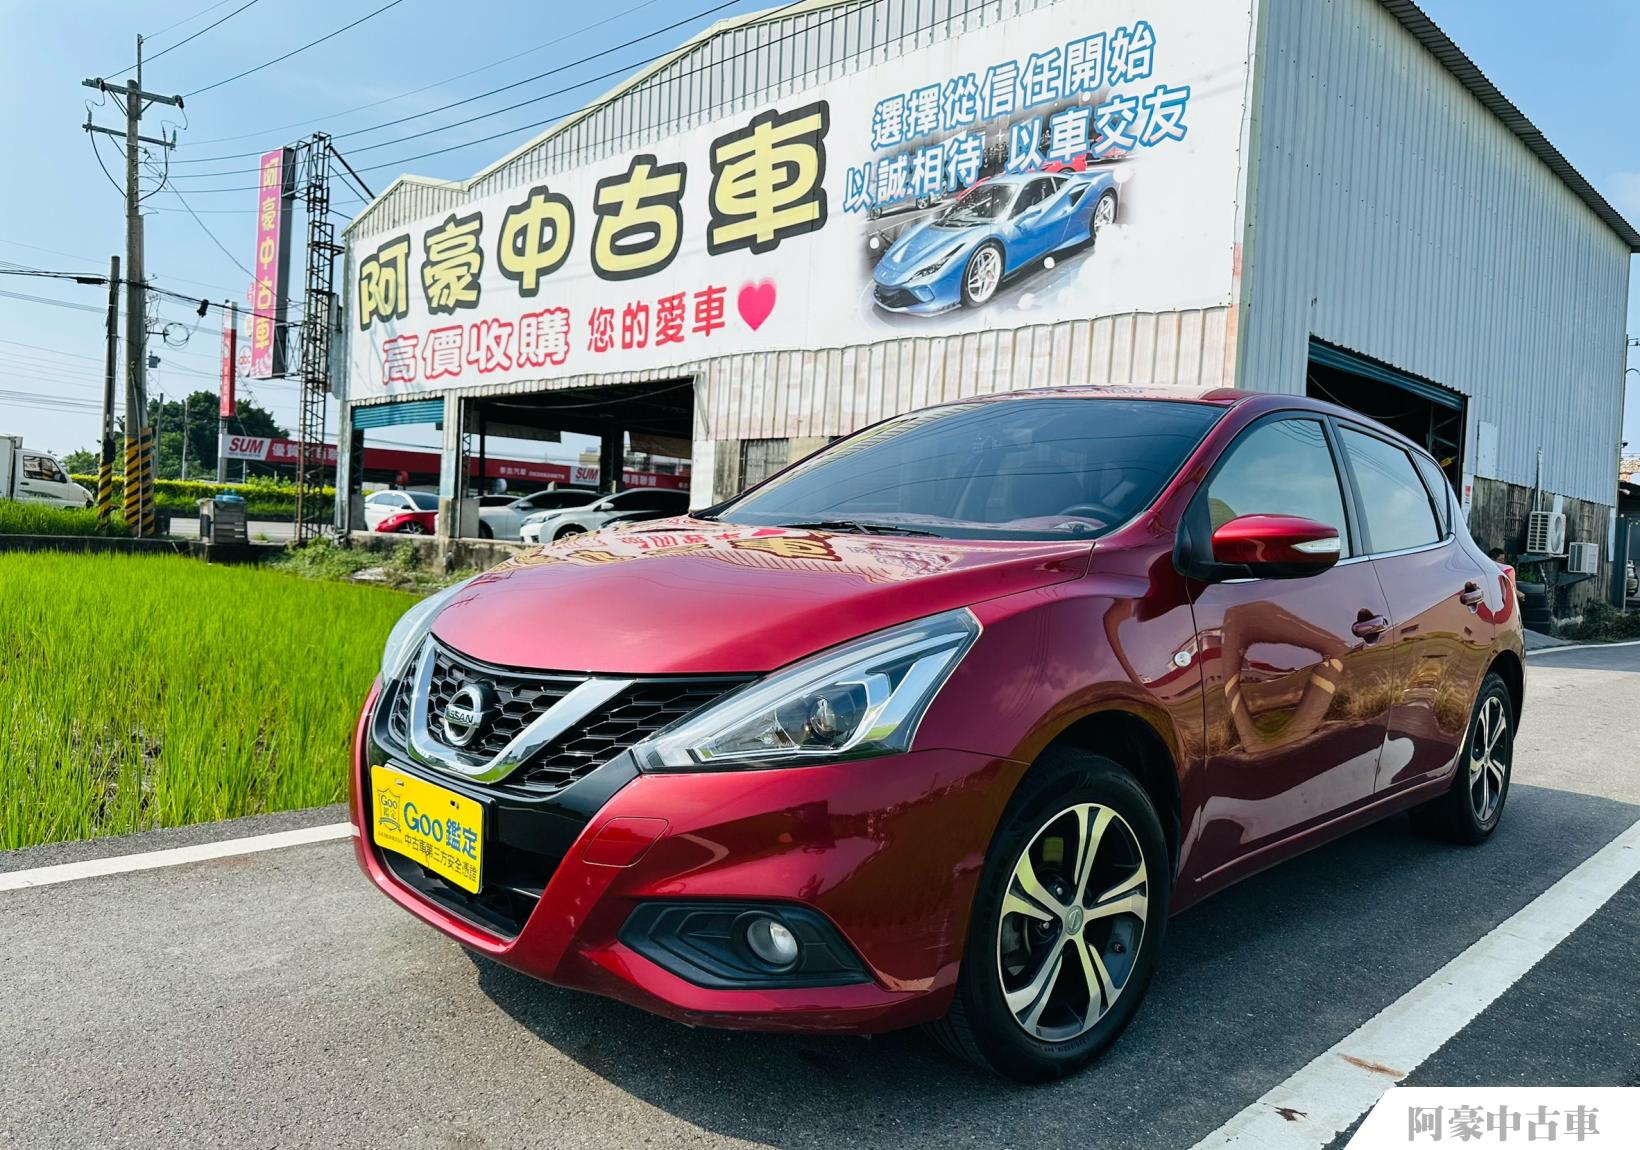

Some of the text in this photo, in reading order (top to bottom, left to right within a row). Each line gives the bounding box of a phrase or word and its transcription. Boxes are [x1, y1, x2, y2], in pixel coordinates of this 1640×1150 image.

[872, 20, 1156, 151] 選擇從信任開始
[842, 84, 1192, 214] 以誠相待 以車交友
[256, 157, 279, 349] 阿豪中古車
[358, 100, 830, 330] 阿豪中古車
[382, 284, 727, 385] 高價收購 您的愛車
[229, 437, 265, 453] SUM
[575, 467, 599, 481] SUM
[380, 794, 398, 810] Goo
